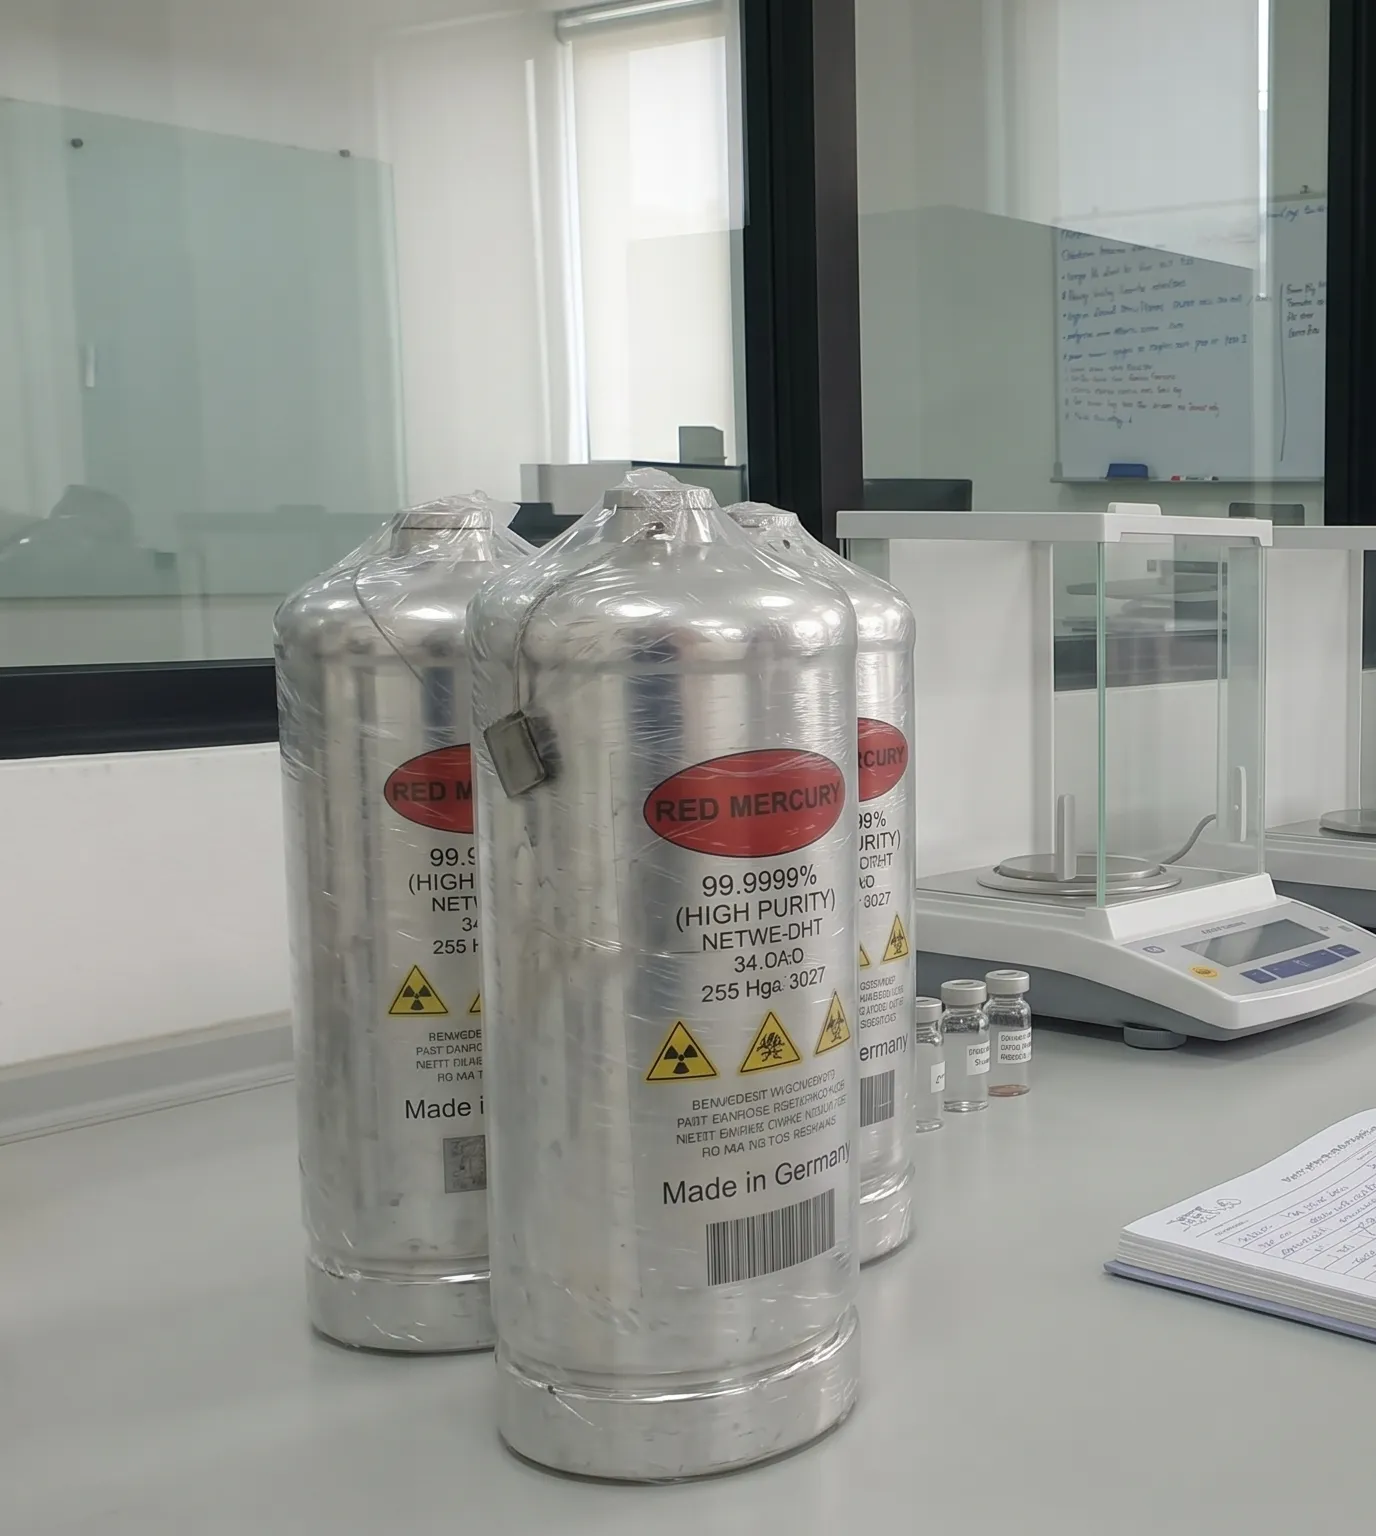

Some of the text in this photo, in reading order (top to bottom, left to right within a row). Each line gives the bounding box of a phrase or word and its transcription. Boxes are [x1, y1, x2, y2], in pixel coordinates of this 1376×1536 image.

[392, 781, 448, 802] RED
[655, 781, 841, 823] RED MERCURY
[702, 863, 818, 898] 99.9999%
[676, 888, 836, 933] (HIGH PURITY)
[432, 939, 468, 956] 255
[702, 917, 824, 952] NETWE-DHT
[701, 982, 740, 1004] 255
[789, 966, 827, 991] 3027
[405, 1097, 472, 1119] Made
[663, 1139, 851, 1205] Made in Germany
